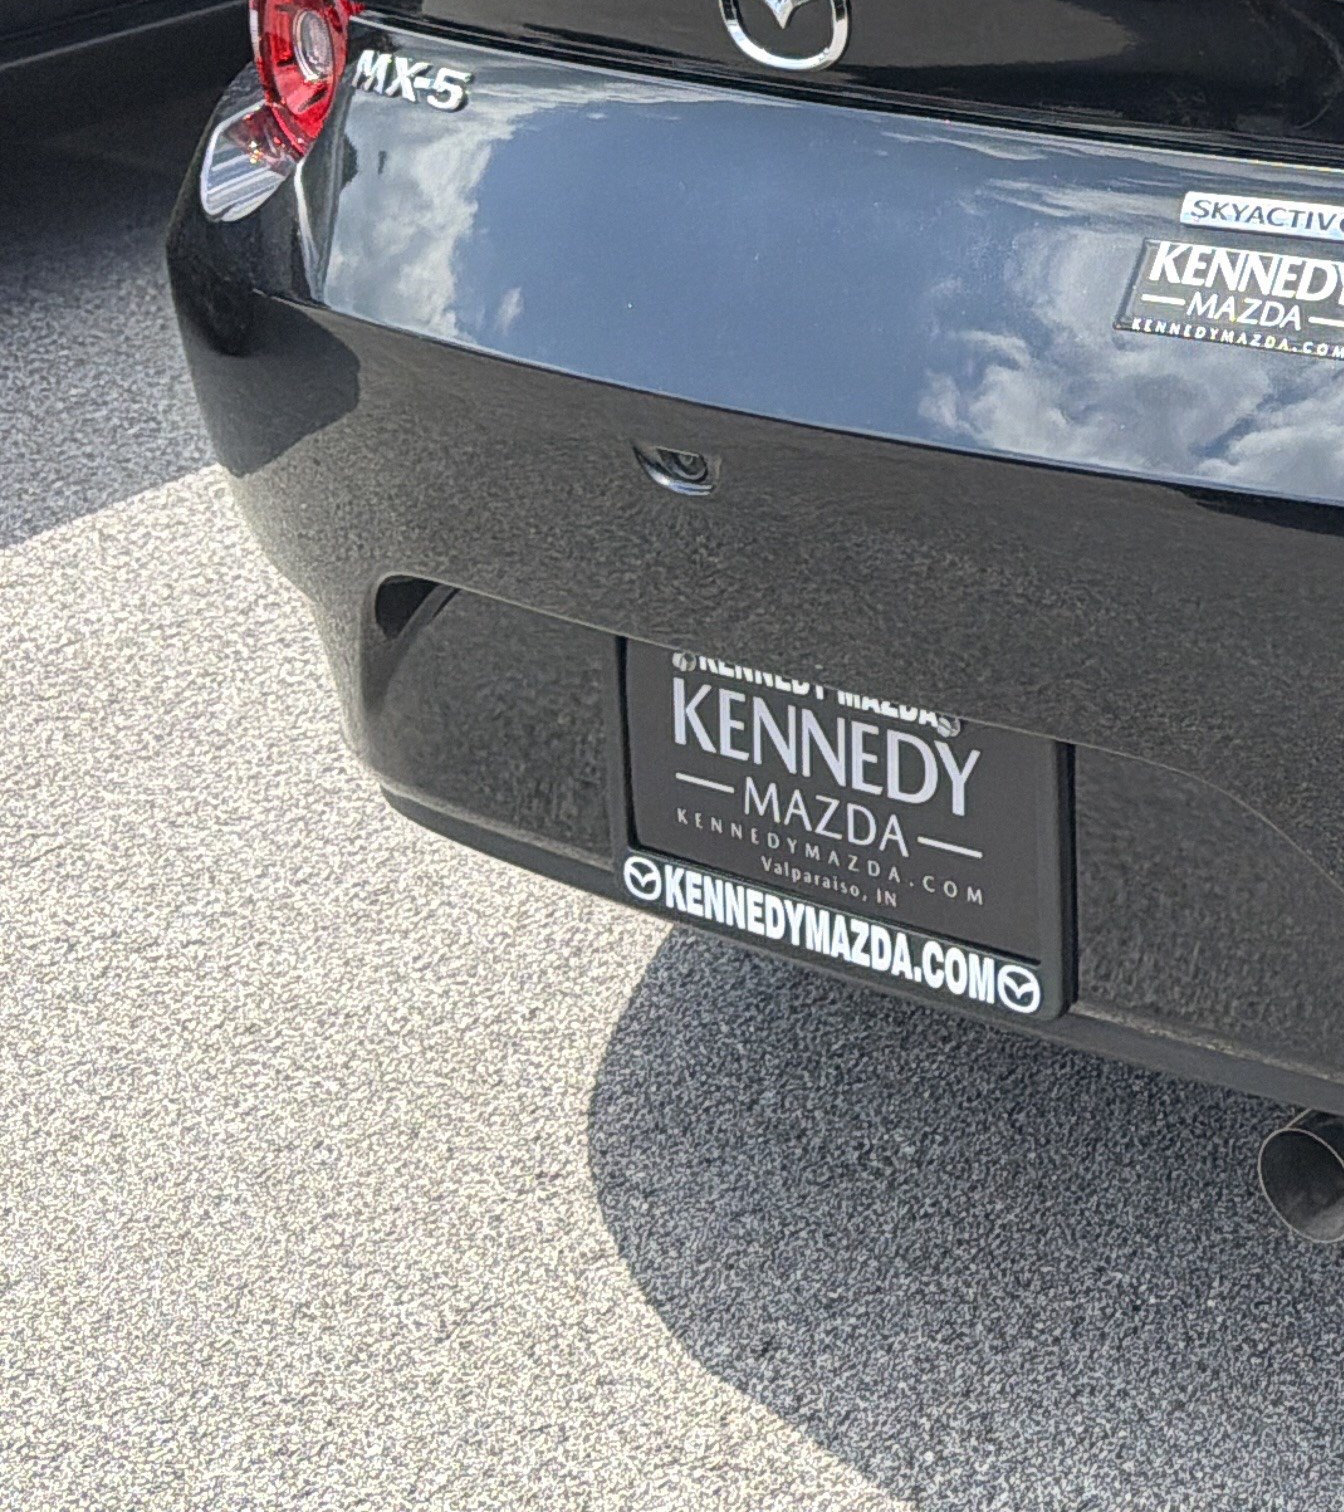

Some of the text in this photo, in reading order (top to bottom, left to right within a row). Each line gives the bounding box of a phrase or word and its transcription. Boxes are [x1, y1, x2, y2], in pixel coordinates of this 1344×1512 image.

[351, 49, 475, 112] MX-5
[1185, 291, 1302, 330] MAZDA
[672, 677, 981, 816] KENNEDY
[677, 808, 984, 906] KENNEDYMAZDA.COM
[743, 777, 909, 858] MAZDA
[664, 864, 996, 1005] KENNEDYMAZDA.COM
[876, 889, 898, 908] IN
